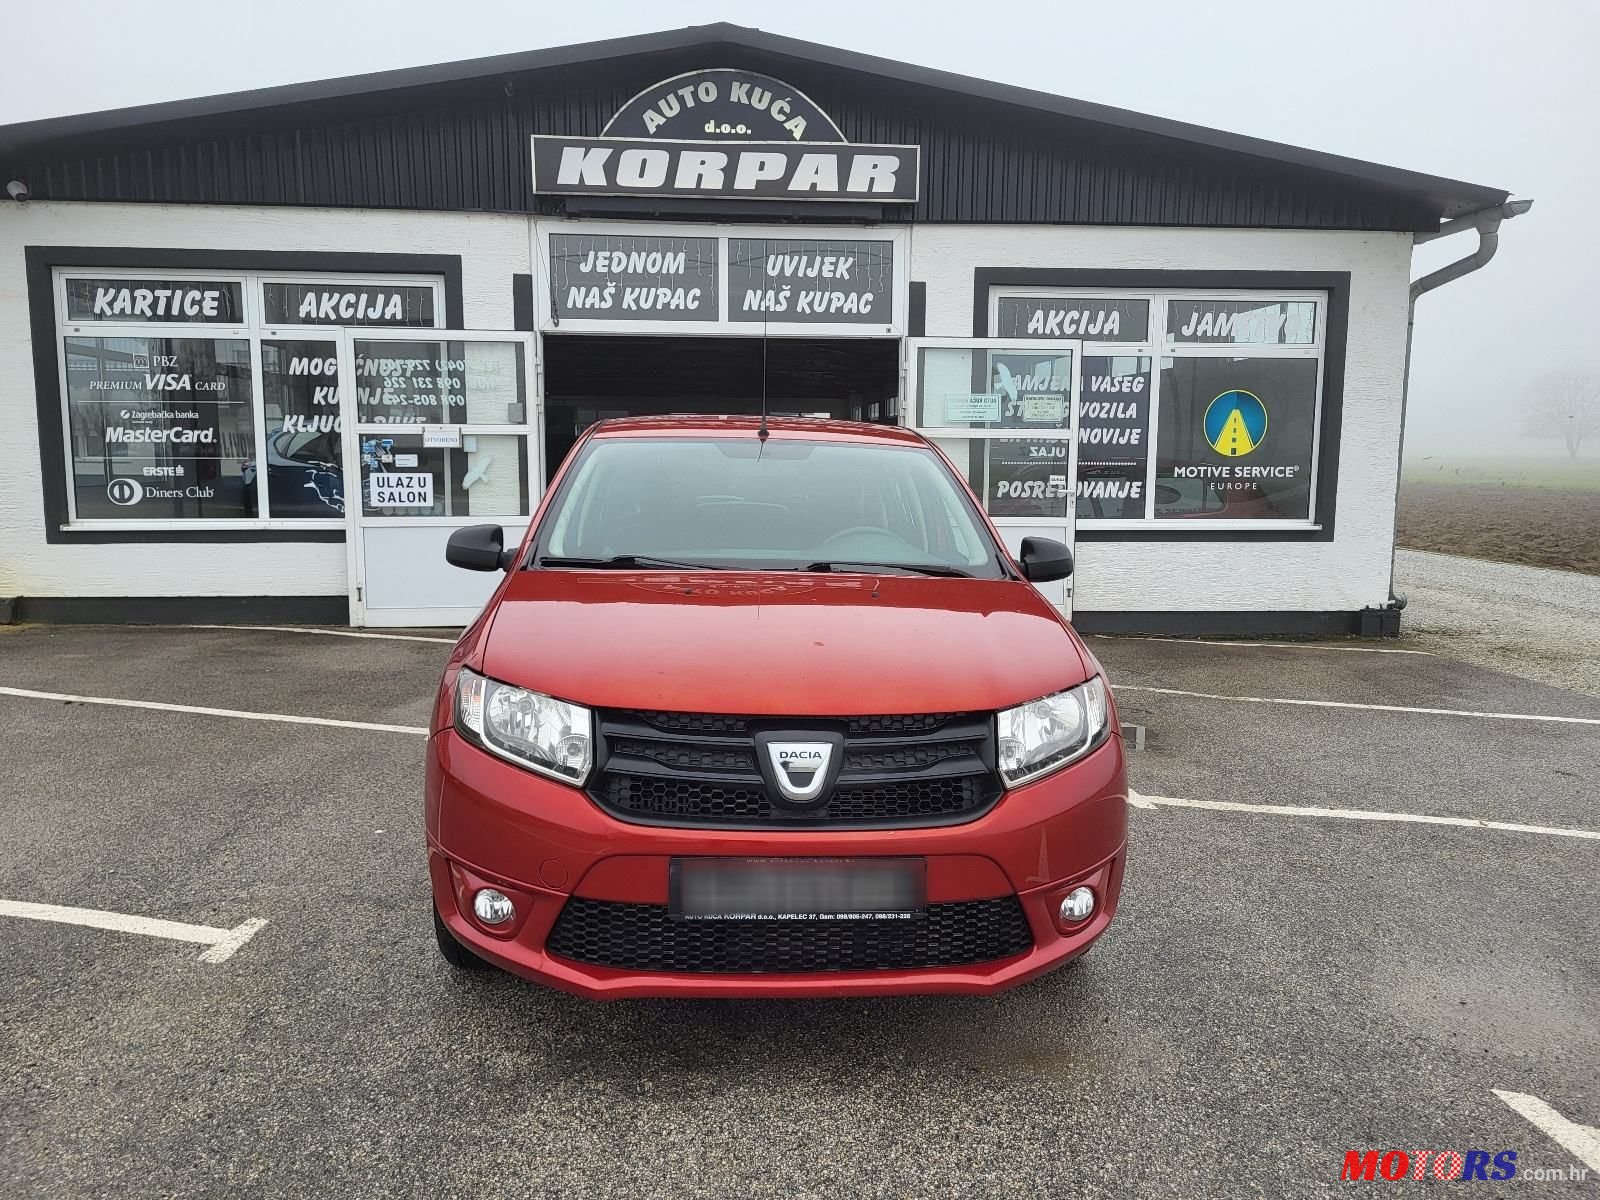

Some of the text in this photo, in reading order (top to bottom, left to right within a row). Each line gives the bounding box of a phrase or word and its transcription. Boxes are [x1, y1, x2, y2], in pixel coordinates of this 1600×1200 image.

[642, 80, 807, 141] AUTO KUĆA
[704, 120, 752, 135] d.o.o.
[556, 146, 900, 193] KORPAR
[579, 250, 686, 275] JEDNOM
[766, 254, 854, 280] UVIJEK
[93, 287, 220, 318] KARTICE
[566, 281, 701, 311] NAŠ KUPAC
[742, 285, 874, 315] NAŠ KUPAC
[298, 291, 403, 321] AKCIJA
[1027, 309, 1120, 336] AKCIJA
[153, 355, 179, 367] PBZ
[289, 354, 411, 377] MOGĆNOST
[89, 373, 226, 391] PREMIUM VISA CARD
[313, 386, 394, 405] KUNJE
[131, 409, 199, 421] Zagrebačka banka
[1080, 402, 1137, 419] VOZILA
[1079, 428, 1142, 445] NOVIJE
[142, 466, 175, 477] ERSTE
[1174, 466, 1230, 478] MOTIVE
[376, 476, 427, 488] ULAZ U
[1210, 483, 1258, 491] EUROPE
[146, 486, 214, 498] Diners Club
[377, 491, 427, 503] SALON
[779, 751, 822, 760] DACIA
